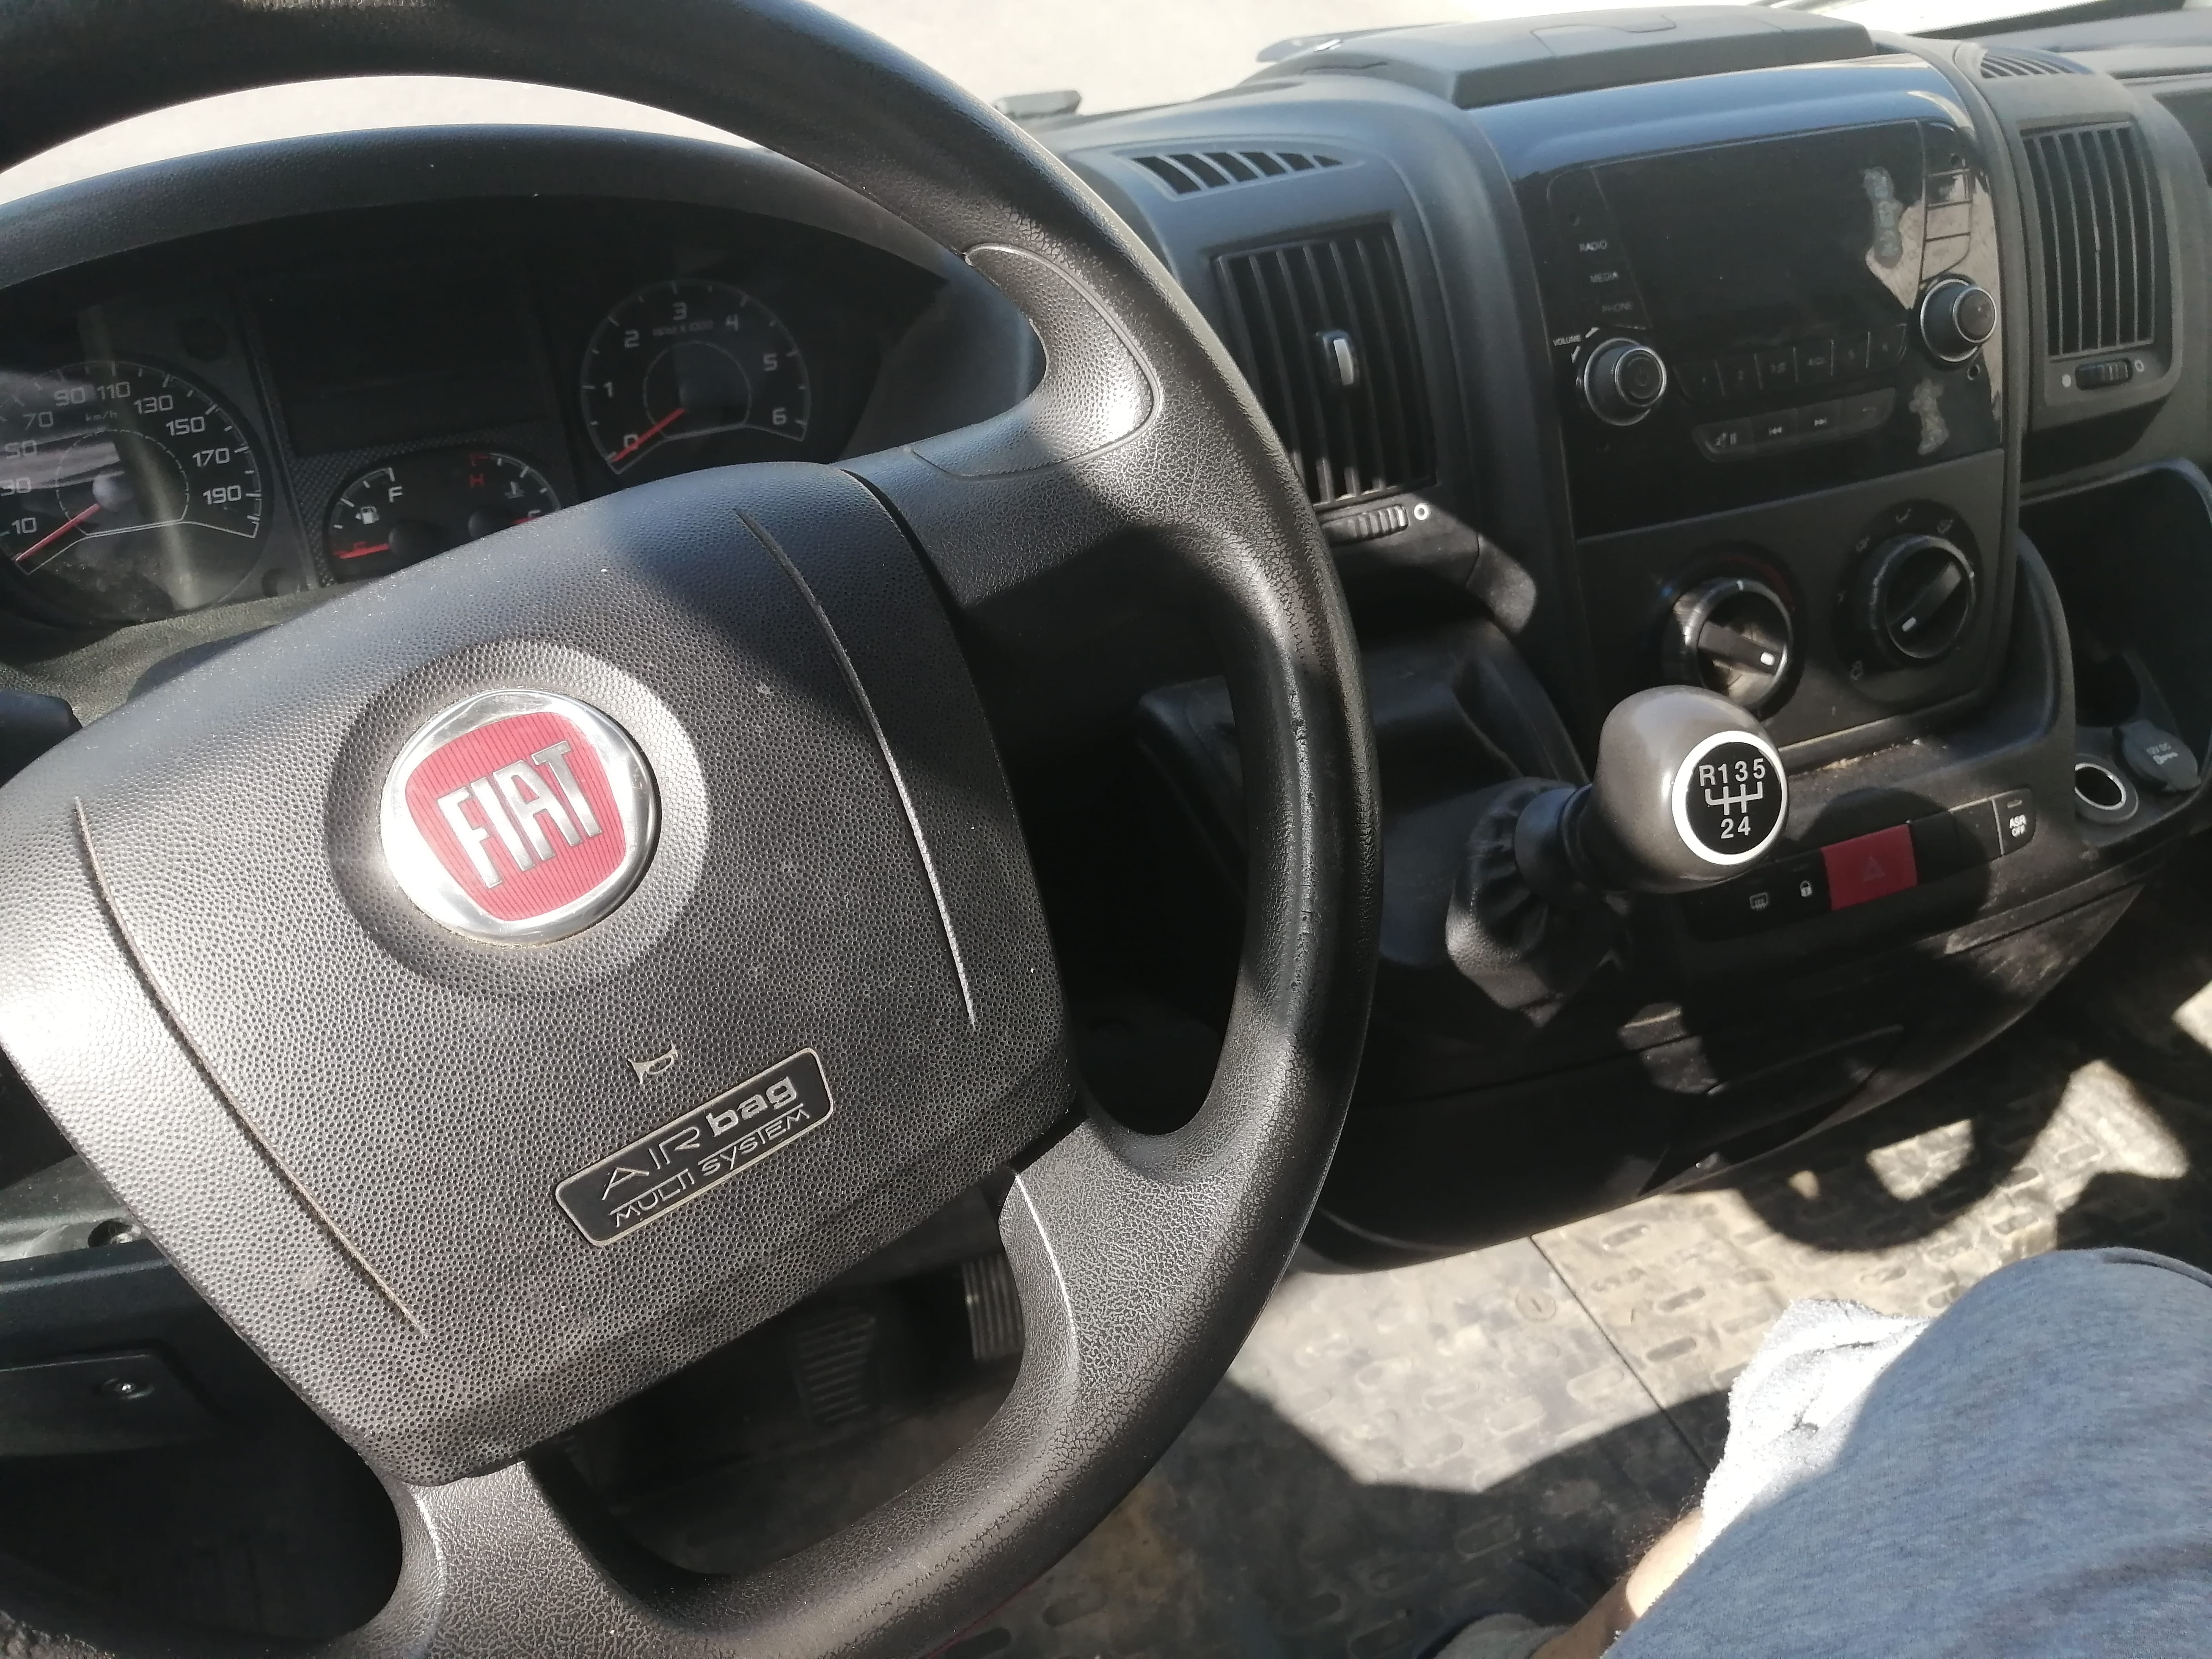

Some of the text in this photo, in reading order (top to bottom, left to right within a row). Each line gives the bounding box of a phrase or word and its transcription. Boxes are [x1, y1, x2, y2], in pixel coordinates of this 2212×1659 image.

[672, 302, 687, 320] 3
[725, 315, 739, 331] 4
[624, 330, 639, 348] 2
[1553, 334, 1582, 346] VOLUME
[763, 354, 778, 371] 5
[53, 387, 86, 406] 90
[97, 381, 131, 399] 110
[604, 381, 613, 397] 1
[134, 395, 174, 414] 130
[24, 411, 53, 430] 70
[772, 407, 786, 425] 6
[166, 416, 205, 436] 150
[5, 440, 37, 460] 50
[192, 448, 230, 467] 170
[203, 485, 242, 505] 190
[389, 486, 403, 502] F
[12, 517, 37, 535] 10
[437, 740, 602, 889] FIAT
[602, 1075, 798, 1201] AIR bag
[609, 1104, 810, 1228] MULTI SYSTEM
